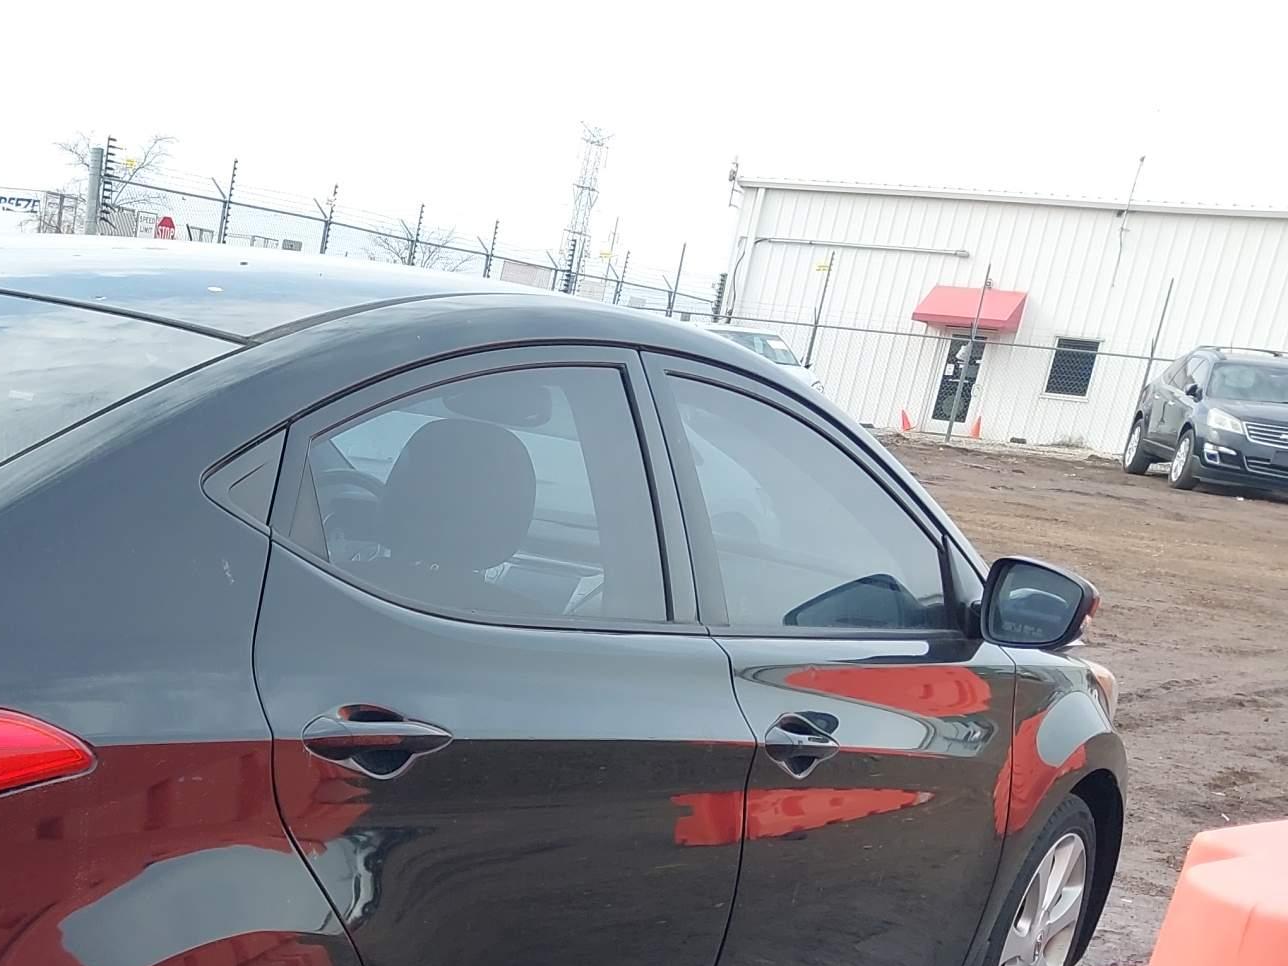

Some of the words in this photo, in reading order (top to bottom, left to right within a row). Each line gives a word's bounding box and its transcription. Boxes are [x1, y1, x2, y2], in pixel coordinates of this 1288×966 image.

[139, 215, 156, 224] SPEED
[139, 225, 153, 233] LIMIT
[158, 225, 175, 240] STOP
